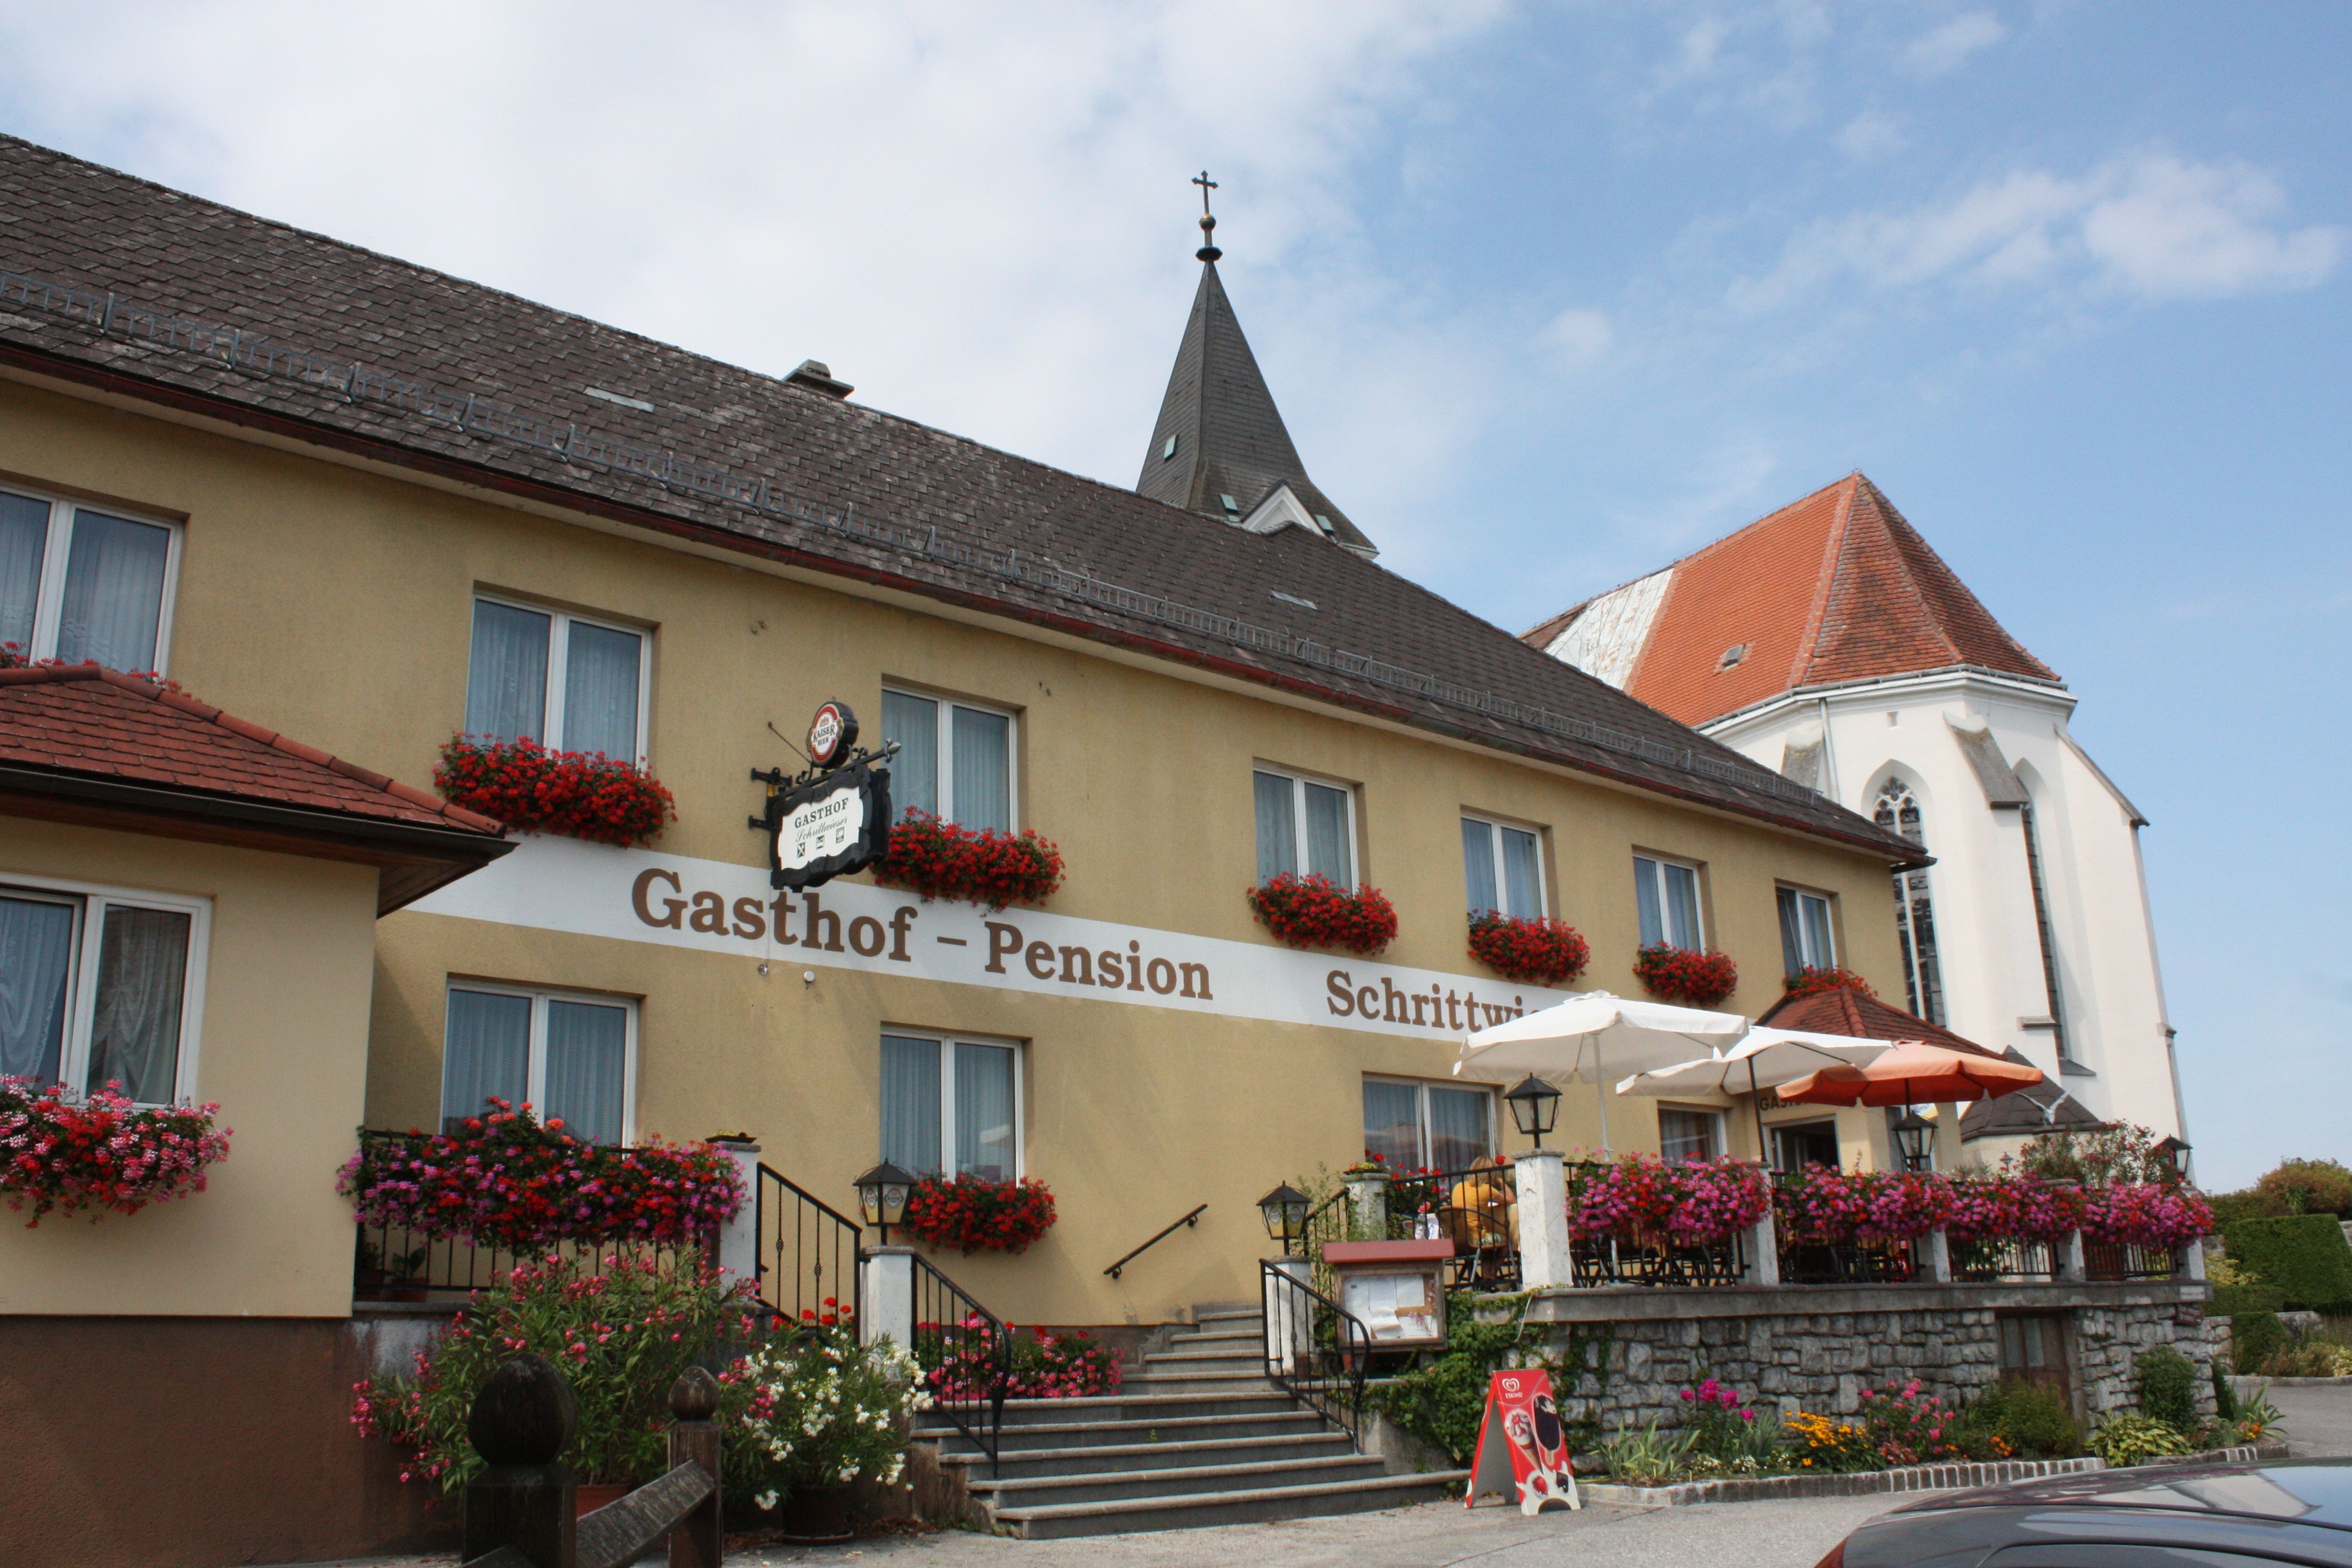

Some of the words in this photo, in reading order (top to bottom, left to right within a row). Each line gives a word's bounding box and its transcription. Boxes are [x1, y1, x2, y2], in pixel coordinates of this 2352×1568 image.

[813, 724, 835, 743] KAISER
[818, 737, 829, 746] BIER
[794, 797, 848, 828] GASTHOF
[631, 868, 918, 962] Gasthof
[984, 921, 1213, 1000] Pension
[1326, 970, 1542, 1033] Schrittwi
